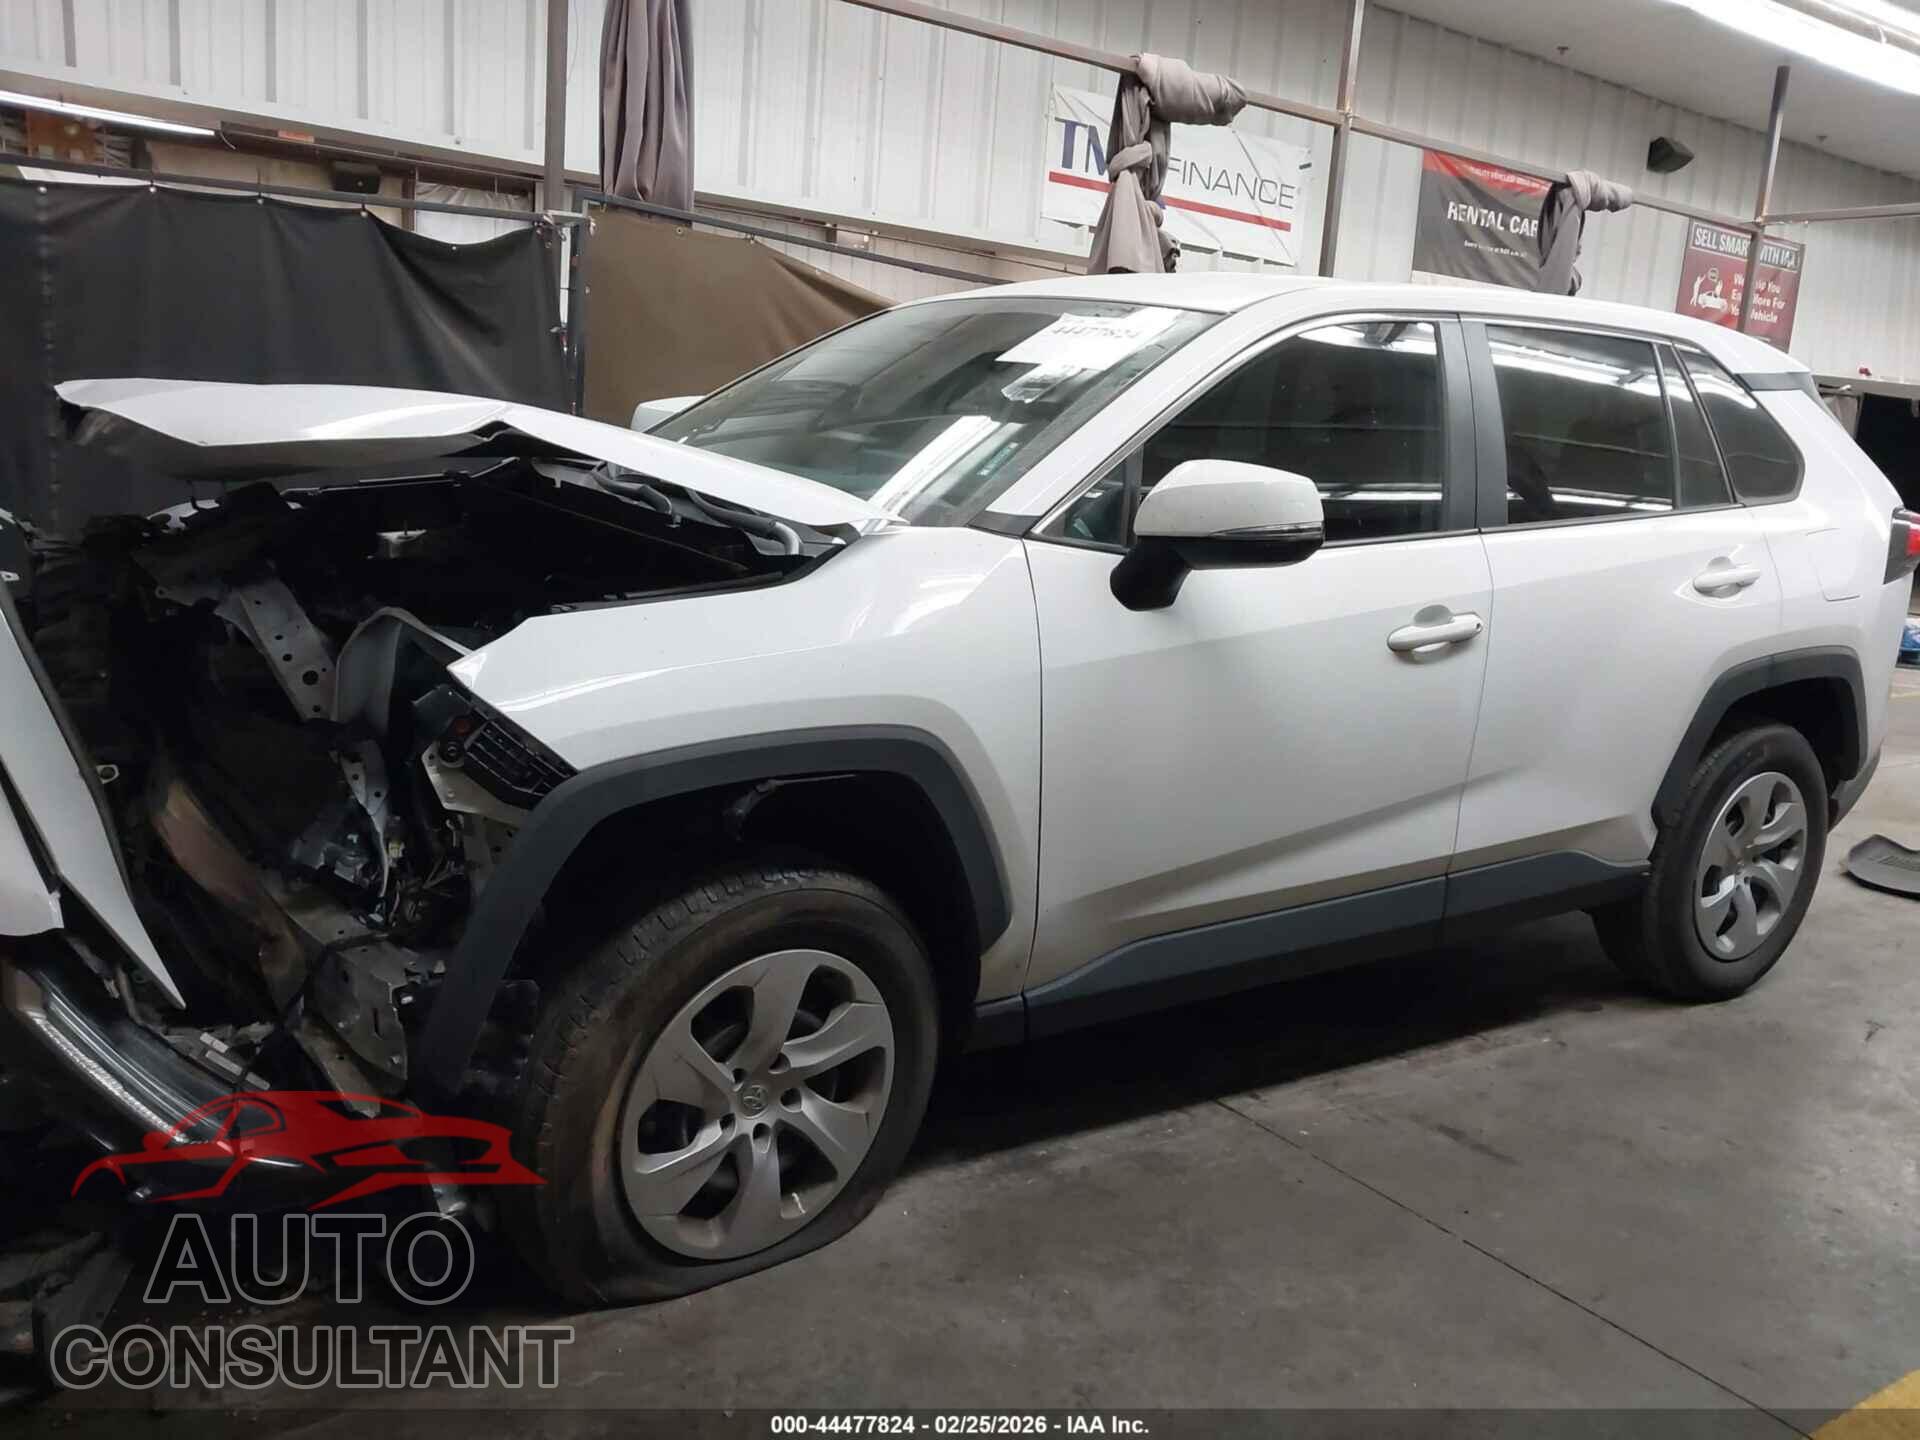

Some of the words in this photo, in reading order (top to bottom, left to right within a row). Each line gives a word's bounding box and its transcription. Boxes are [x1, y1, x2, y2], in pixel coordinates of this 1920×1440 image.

[1168, 156, 1295, 209] FINANCE
[1447, 201, 1504, 231] RENTAL
[1695, 227, 1717, 249] SELL
[1719, 234, 1750, 257] SMAR
